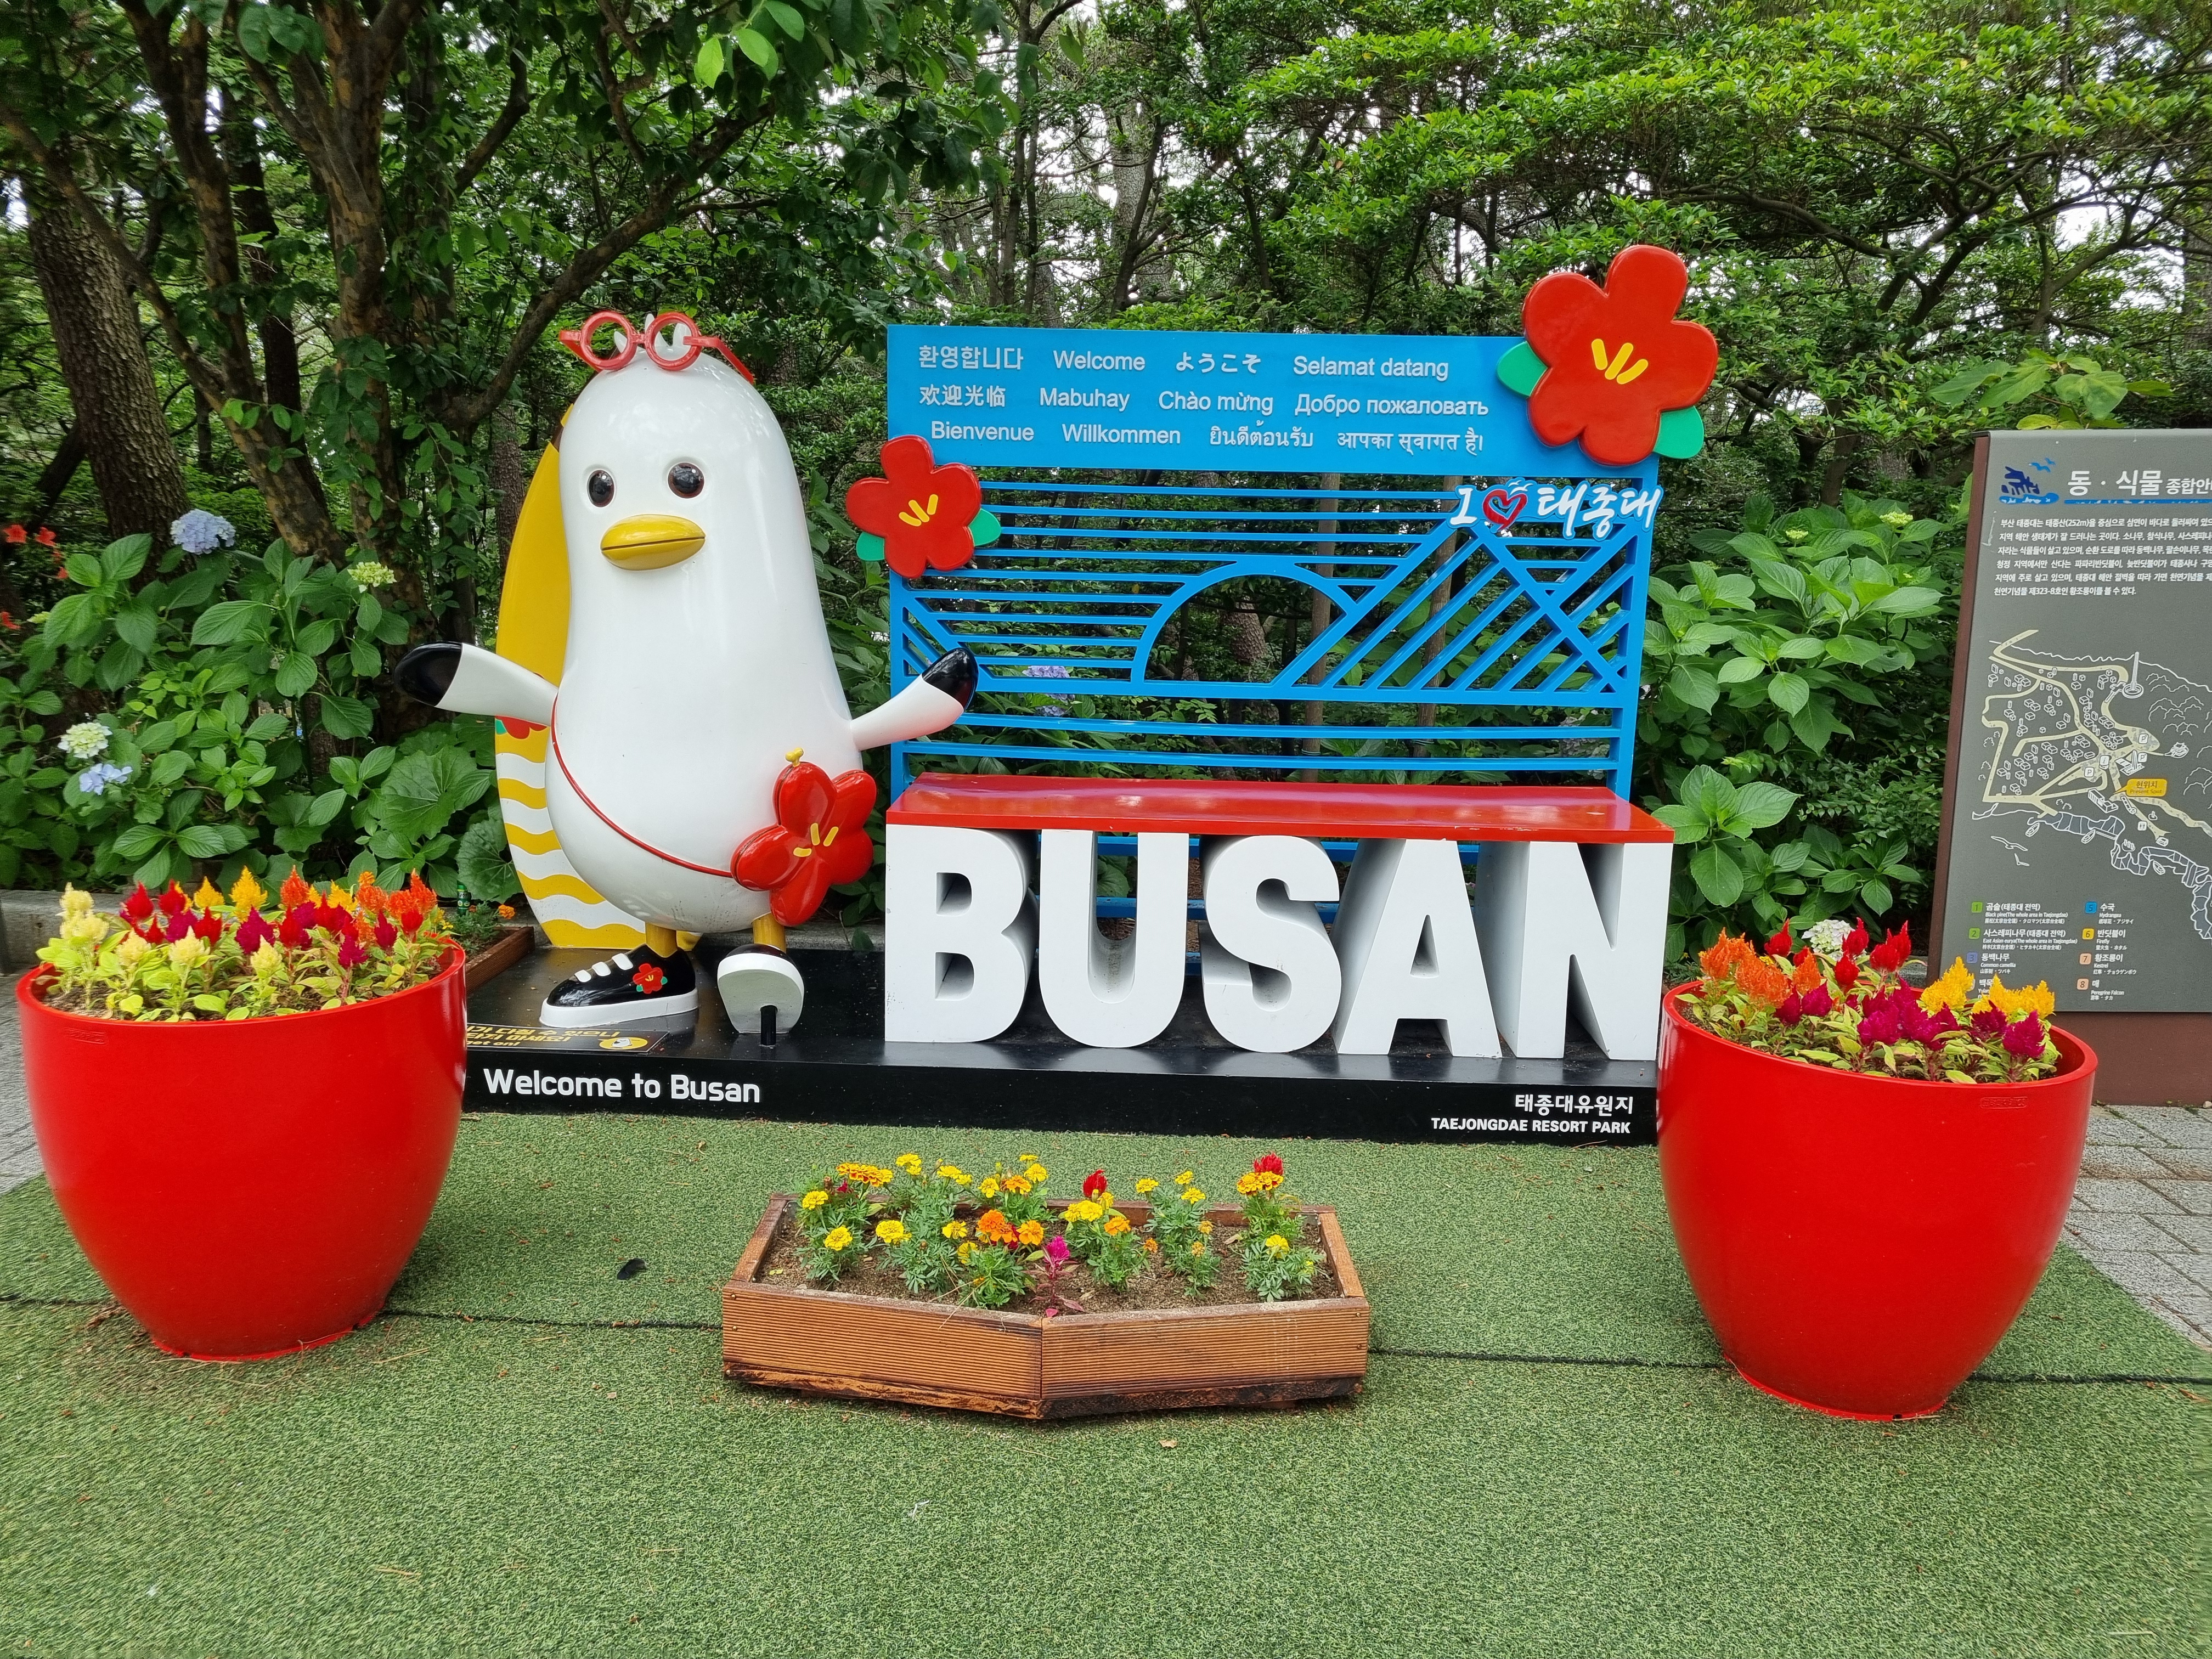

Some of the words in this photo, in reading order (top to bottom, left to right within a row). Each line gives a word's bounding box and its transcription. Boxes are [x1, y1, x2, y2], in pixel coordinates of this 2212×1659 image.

[918, 345, 1024, 370] 환영합니다
[1053, 350, 1146, 371] Welcome
[1176, 352, 1261, 374] ようこそ
[1293, 356, 1375, 376] Selamat
[1380, 357, 1448, 382] datang
[919, 384, 1006, 408] 欢迎光临
[1040, 388, 1130, 412] Mabuhay
[1159, 391, 1211, 410] Chào
[1217, 392, 1273, 415] mừng
[1295, 394, 1360, 416] Добро
[1367, 399, 1489, 416] пожаловать
[931, 420, 1034, 441] Bienvenue
[1062, 424, 1181, 444] Willkommen
[1210, 420, 1314, 447] ยินดีต้อนรับ
[1337, 432, 1394, 449] आपका
[2068, 471, 2091, 495] 동
[2116, 470, 2163, 495] 식물
[2166, 478, 2212, 494] 종합안
[1450, 488, 1477, 526] I
[1537, 483, 1661, 538] 태종대
[2001, 519, 2015, 527] 부산
[2016, 519, 2044, 528] 태종대는
[2098, 518, 2125, 527] 중심으로
[2127, 518, 2147, 527] 삼면이
[2149, 518, 2170, 527] 바다로
[1999, 533, 2013, 541] 지역
[2015, 533, 2029, 541] 해안
[2031, 533, 2058, 541] 생태계가
[2060, 533, 2068, 541] 잘
[2069, 533, 2097, 541] 드러나는
[2098, 532, 2120, 540] 곳이다.
[2123, 532, 2145, 540] 소나무,
[2147, 532, 2175, 540] 참식나무,
[1997, 546, 2018, 555] 자라는
[2019, 546, 2046, 555] 식물들이
[2047, 546, 2061, 555] 살고
[2062, 546, 2084, 555] 있으며,
[2085, 546, 2099, 555] 순환
[2100, 546, 2120, 554] 도로를
[2121, 546, 2135, 554] 따라
[2136, 546, 2165, 554] 동백나무,
[1996, 560, 2010, 568] 청정
[2014, 560, 2047, 568] 지역에서만
[2051, 560, 2072, 568] 산다는
[2127, 560, 2167, 568] 늦반딧불이가
[2170, 560, 2198, 568] 태종사나
[1995, 574, 2016, 582] 지역에
[2018, 574, 2032, 582] 주로
[2034, 574, 2049, 582] 살고
[2051, 574, 2073, 582] 있으며,
[2075, 574, 2096, 582] 태종대
[2098, 573, 2112, 582] 해안
[2115, 573, 2135, 582] 절벽을
[2137, 573, 2151, 582] 따라
[2154, 573, 2168, 582] 가면
[2170, 573, 2204, 582] 천연기념물
[1994, 588, 2027, 596] 천연기념물
[2029, 588, 2068, 596] 제323-8호인
[2069, 587, 2103, 596] 황조롱이를
[2121, 587, 2136, 595] 있다.
[2024, 903, 2040, 911] 전역)
[2100, 903, 2115, 911] 수국
[2050, 929, 2066, 937] 전역)
[2097, 929, 2126, 938] 반딧불이
[885, 825, 1673, 1060] BUSAN
[1981, 953, 2010, 962] 동백나무
[2095, 953, 2123, 962] 황조롱이
[1979, 979, 1993, 987] 백목
[2092, 979, 2100, 988] 매
[483, 1069, 621, 1097] Welcome
[632, 1073, 661, 1098] to
[671, 1074, 760, 1103] Busan
[1515, 1094, 1633, 1116] 태종대유원지
[1431, 1118, 1527, 1132] TAEJONGDAE
[1533, 1120, 1588, 1133] RESORT
[1592, 1121, 1630, 1133] PARK
